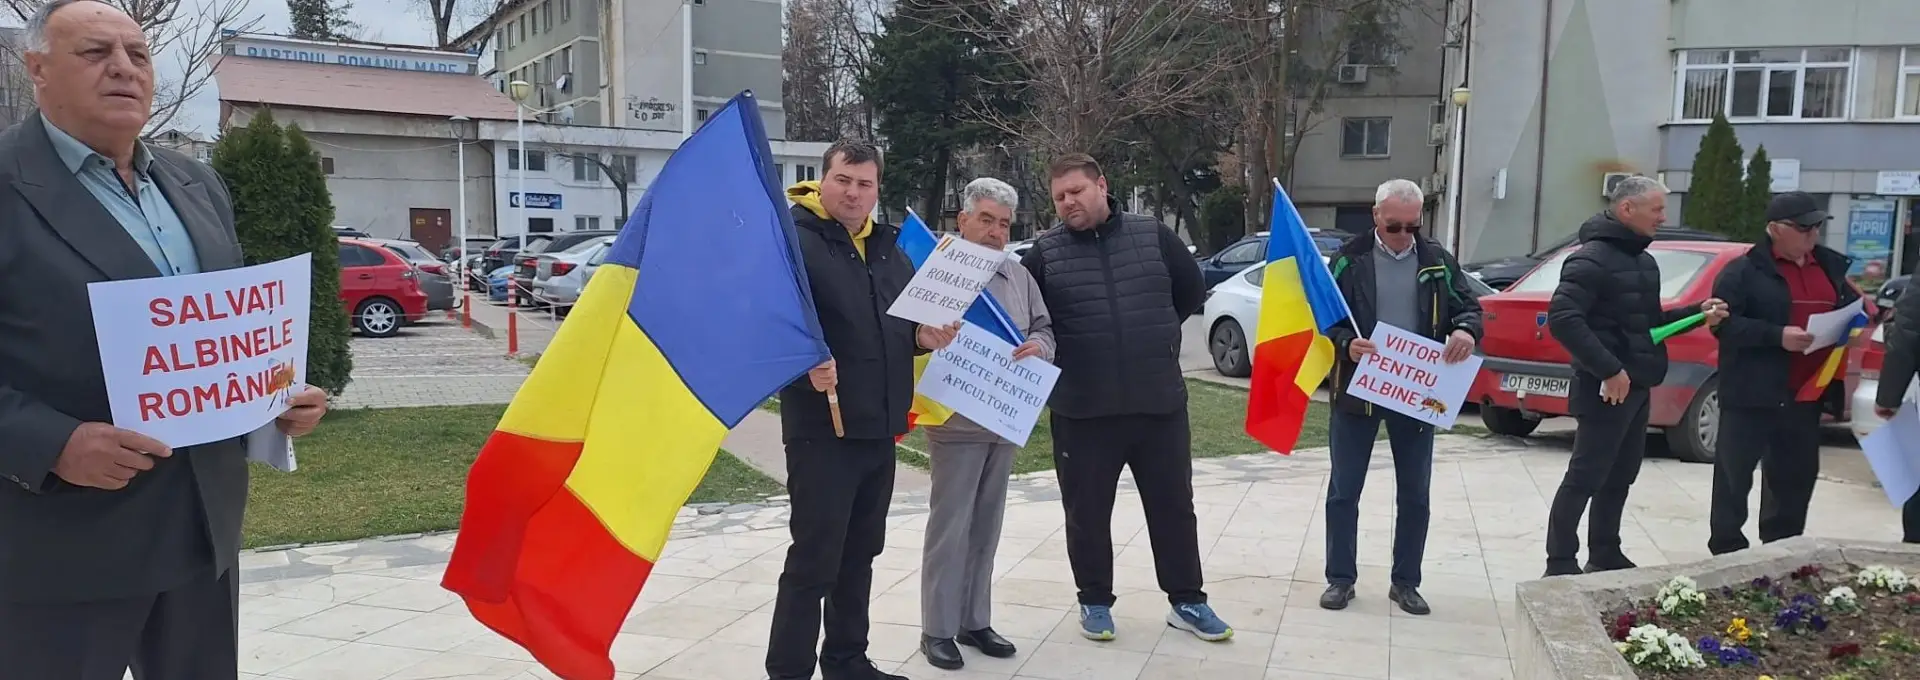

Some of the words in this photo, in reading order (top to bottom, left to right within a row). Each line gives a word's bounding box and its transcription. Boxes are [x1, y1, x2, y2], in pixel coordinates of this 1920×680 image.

[149, 279, 285, 327] SALVAȚI
[907, 285, 940, 303] CERE
[142, 318, 293, 376] ALBINELE
[956, 334, 991, 357] VREM
[992, 353, 1042, 386] POLITICI
[1367, 353, 1438, 387] PENTRU
[1385, 333, 1440, 364] VIITOR
[138, 361, 286, 422] ROMÂNIE
[937, 348, 993, 382] CORECTE
[994, 376, 1042, 408] PENTRU
[942, 373, 1018, 419] APICULTORI!
[1355, 374, 1420, 406] ALBINE
[1509, 376, 1525, 389] OT
